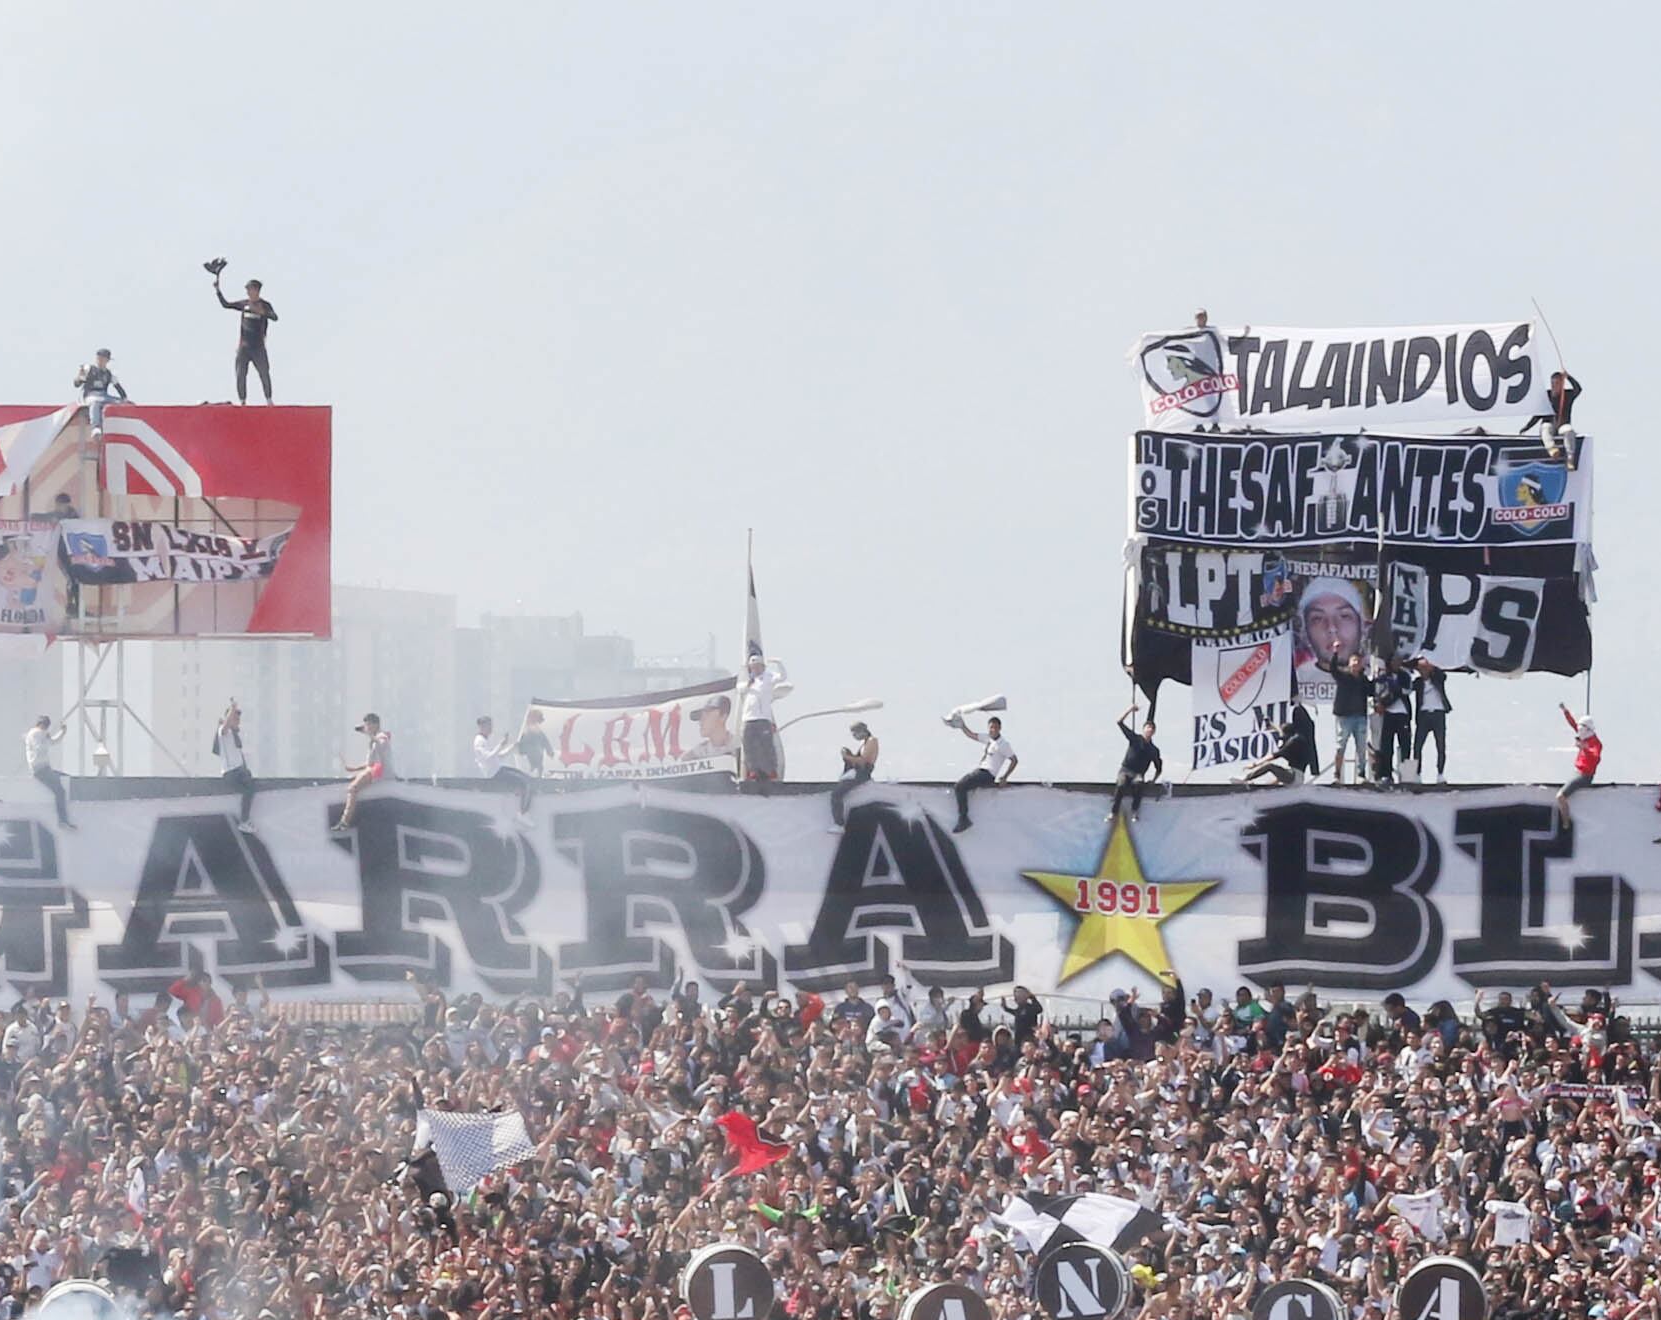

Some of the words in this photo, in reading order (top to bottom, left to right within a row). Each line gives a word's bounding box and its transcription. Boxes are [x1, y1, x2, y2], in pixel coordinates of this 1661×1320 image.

[1227, 323, 1534, 417] TALAINDIOS
[1165, 552, 1265, 628] LPT
[1194, 711, 1227, 744] ES
[1076, 879, 1162, 916] 1991
[710, 1262, 754, 1320] L
[1055, 1258, 1103, 1319] N
